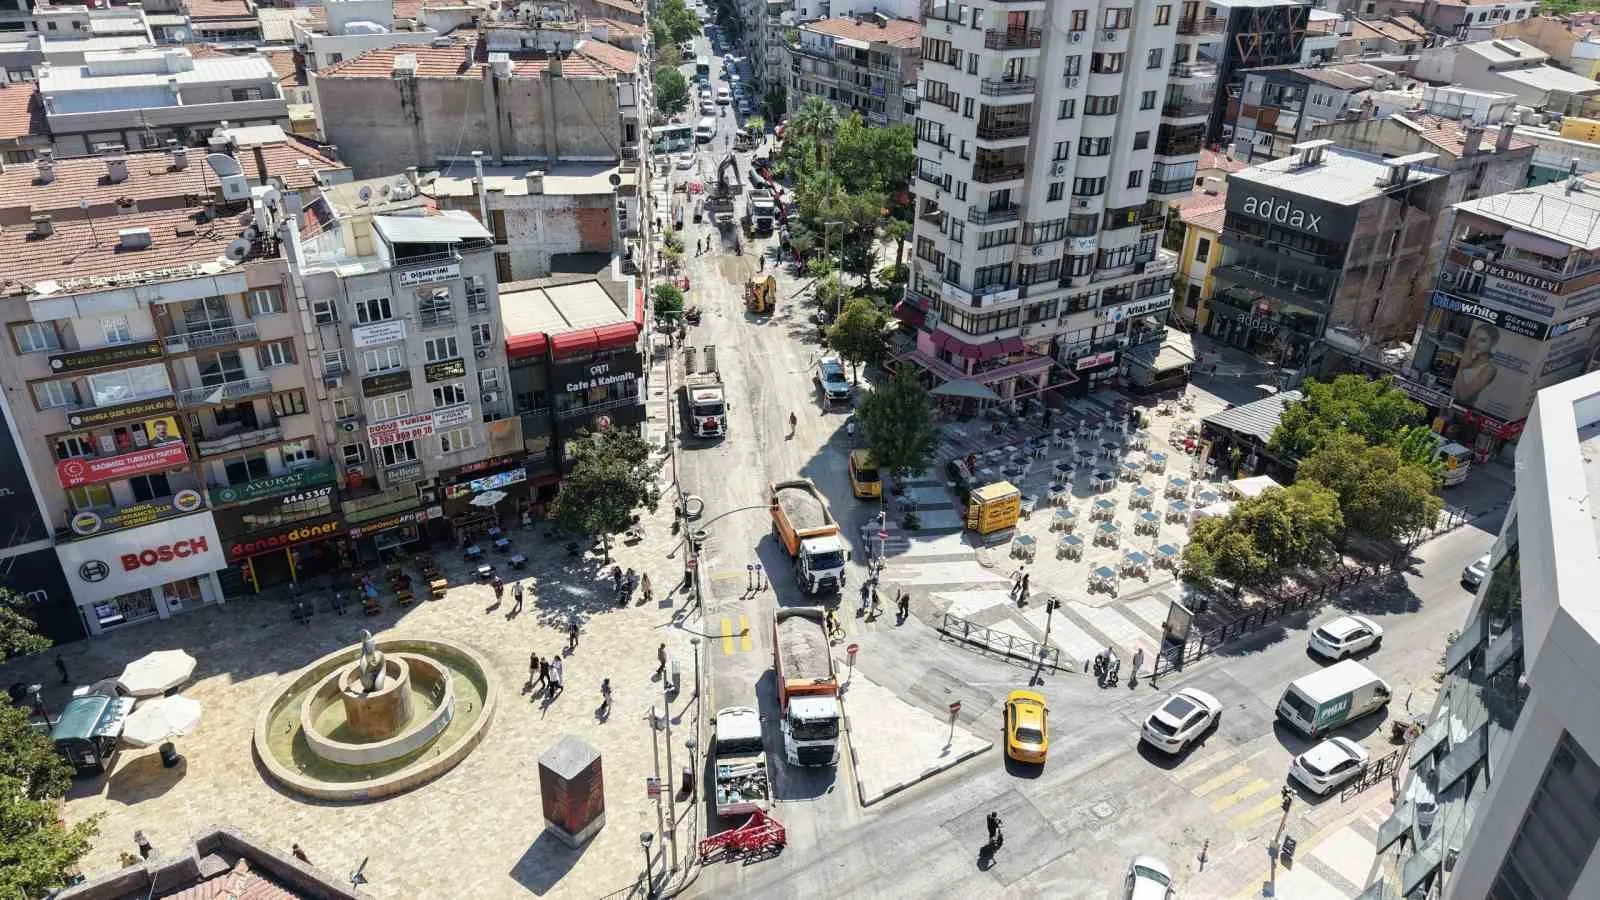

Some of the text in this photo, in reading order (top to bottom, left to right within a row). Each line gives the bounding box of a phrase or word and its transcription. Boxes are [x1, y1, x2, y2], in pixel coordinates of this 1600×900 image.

[1243, 197, 1322, 232] addax
[1237, 313, 1277, 335] addax
[566, 381, 589, 392] Cafe
[590, 379, 597, 388] &
[245, 472, 304, 492] AVUKAT
[121, 535, 209, 571] BOSCH
